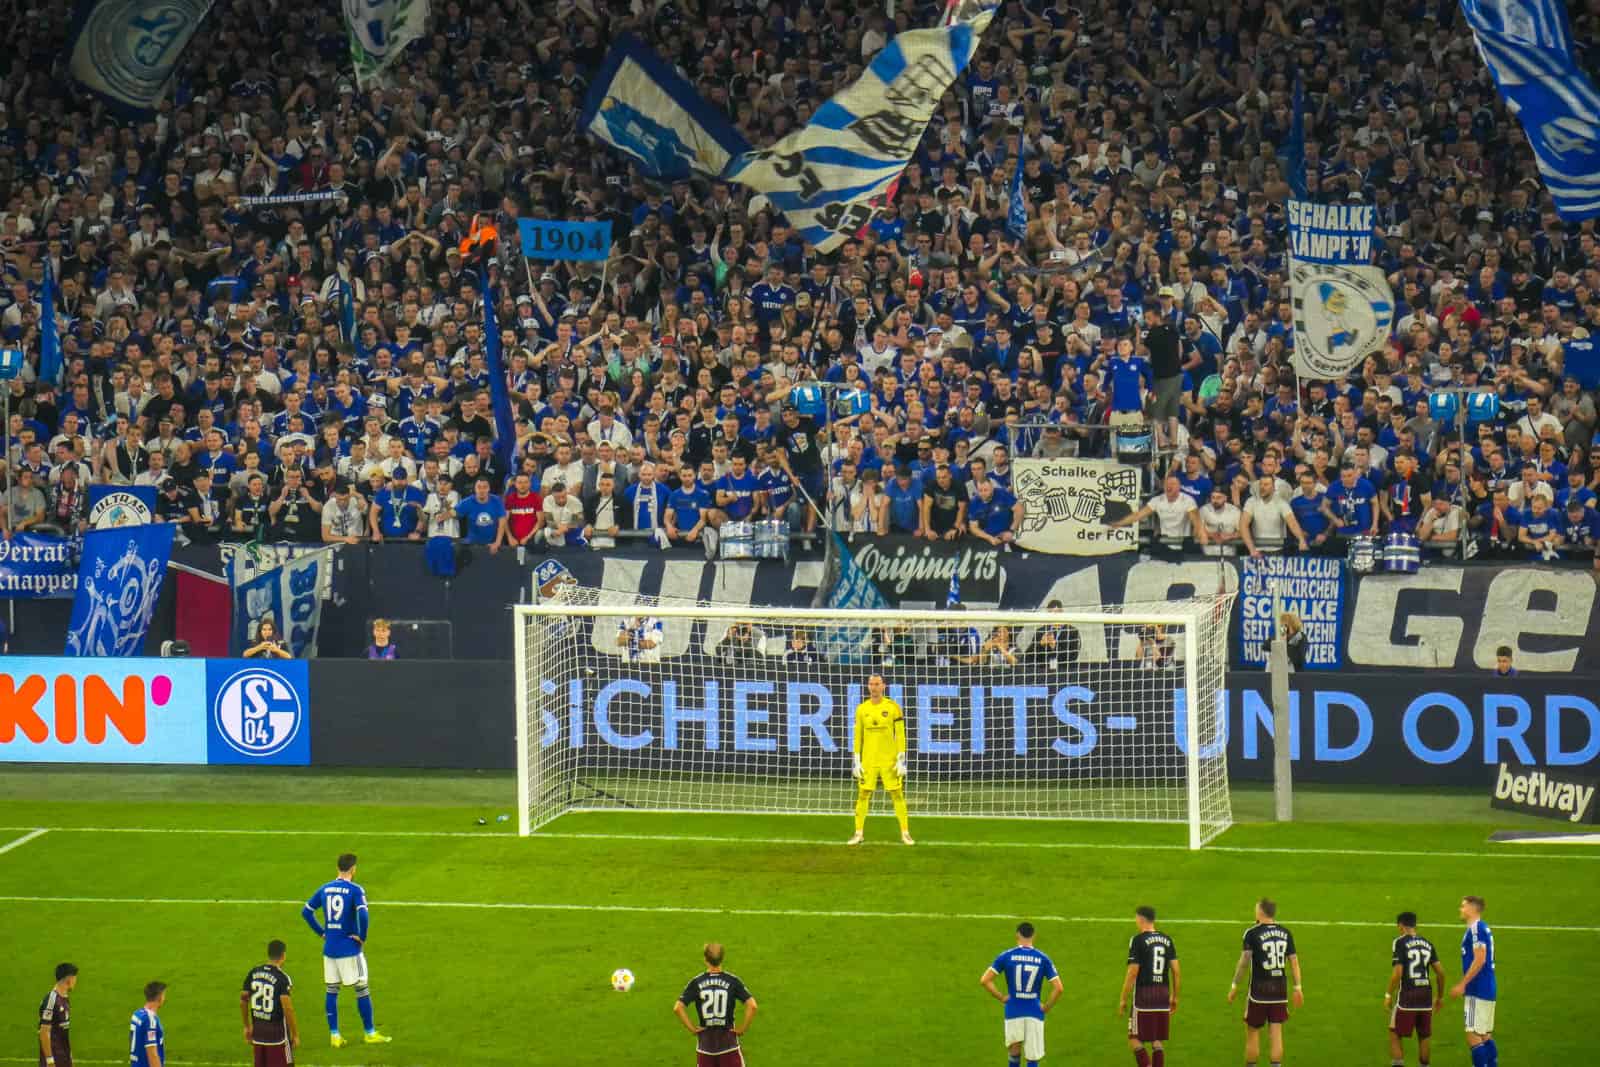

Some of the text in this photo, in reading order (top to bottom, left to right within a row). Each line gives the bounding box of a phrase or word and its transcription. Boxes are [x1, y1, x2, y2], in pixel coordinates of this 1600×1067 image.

[1288, 200, 1373, 230] SCHALKE
[531, 226, 604, 253] 1904
[1041, 465, 1098, 479] Schalke
[95, 493, 148, 514] ULTRAS
[1067, 486, 1078, 498] &
[1077, 528, 1135, 541] der FCN
[0, 540, 66, 563] Verrat
[854, 543, 999, 594] Original 75
[1242, 556, 1340, 578] FSBALLCLUB
[1243, 619, 1272, 641] SEIT
[1174, 687, 1374, 762] UND
[1402, 692, 1600, 766] ORD
[1494, 763, 1595, 823] betway
[326, 893, 345, 922] 19
[1153, 945, 1166, 975] 6
[1262, 940, 1288, 970] 38
[1407, 949, 1431, 979] 27
[1015, 964, 1040, 993] 17
[250, 980, 275, 1013] 28
[699, 988, 729, 1019] 20
